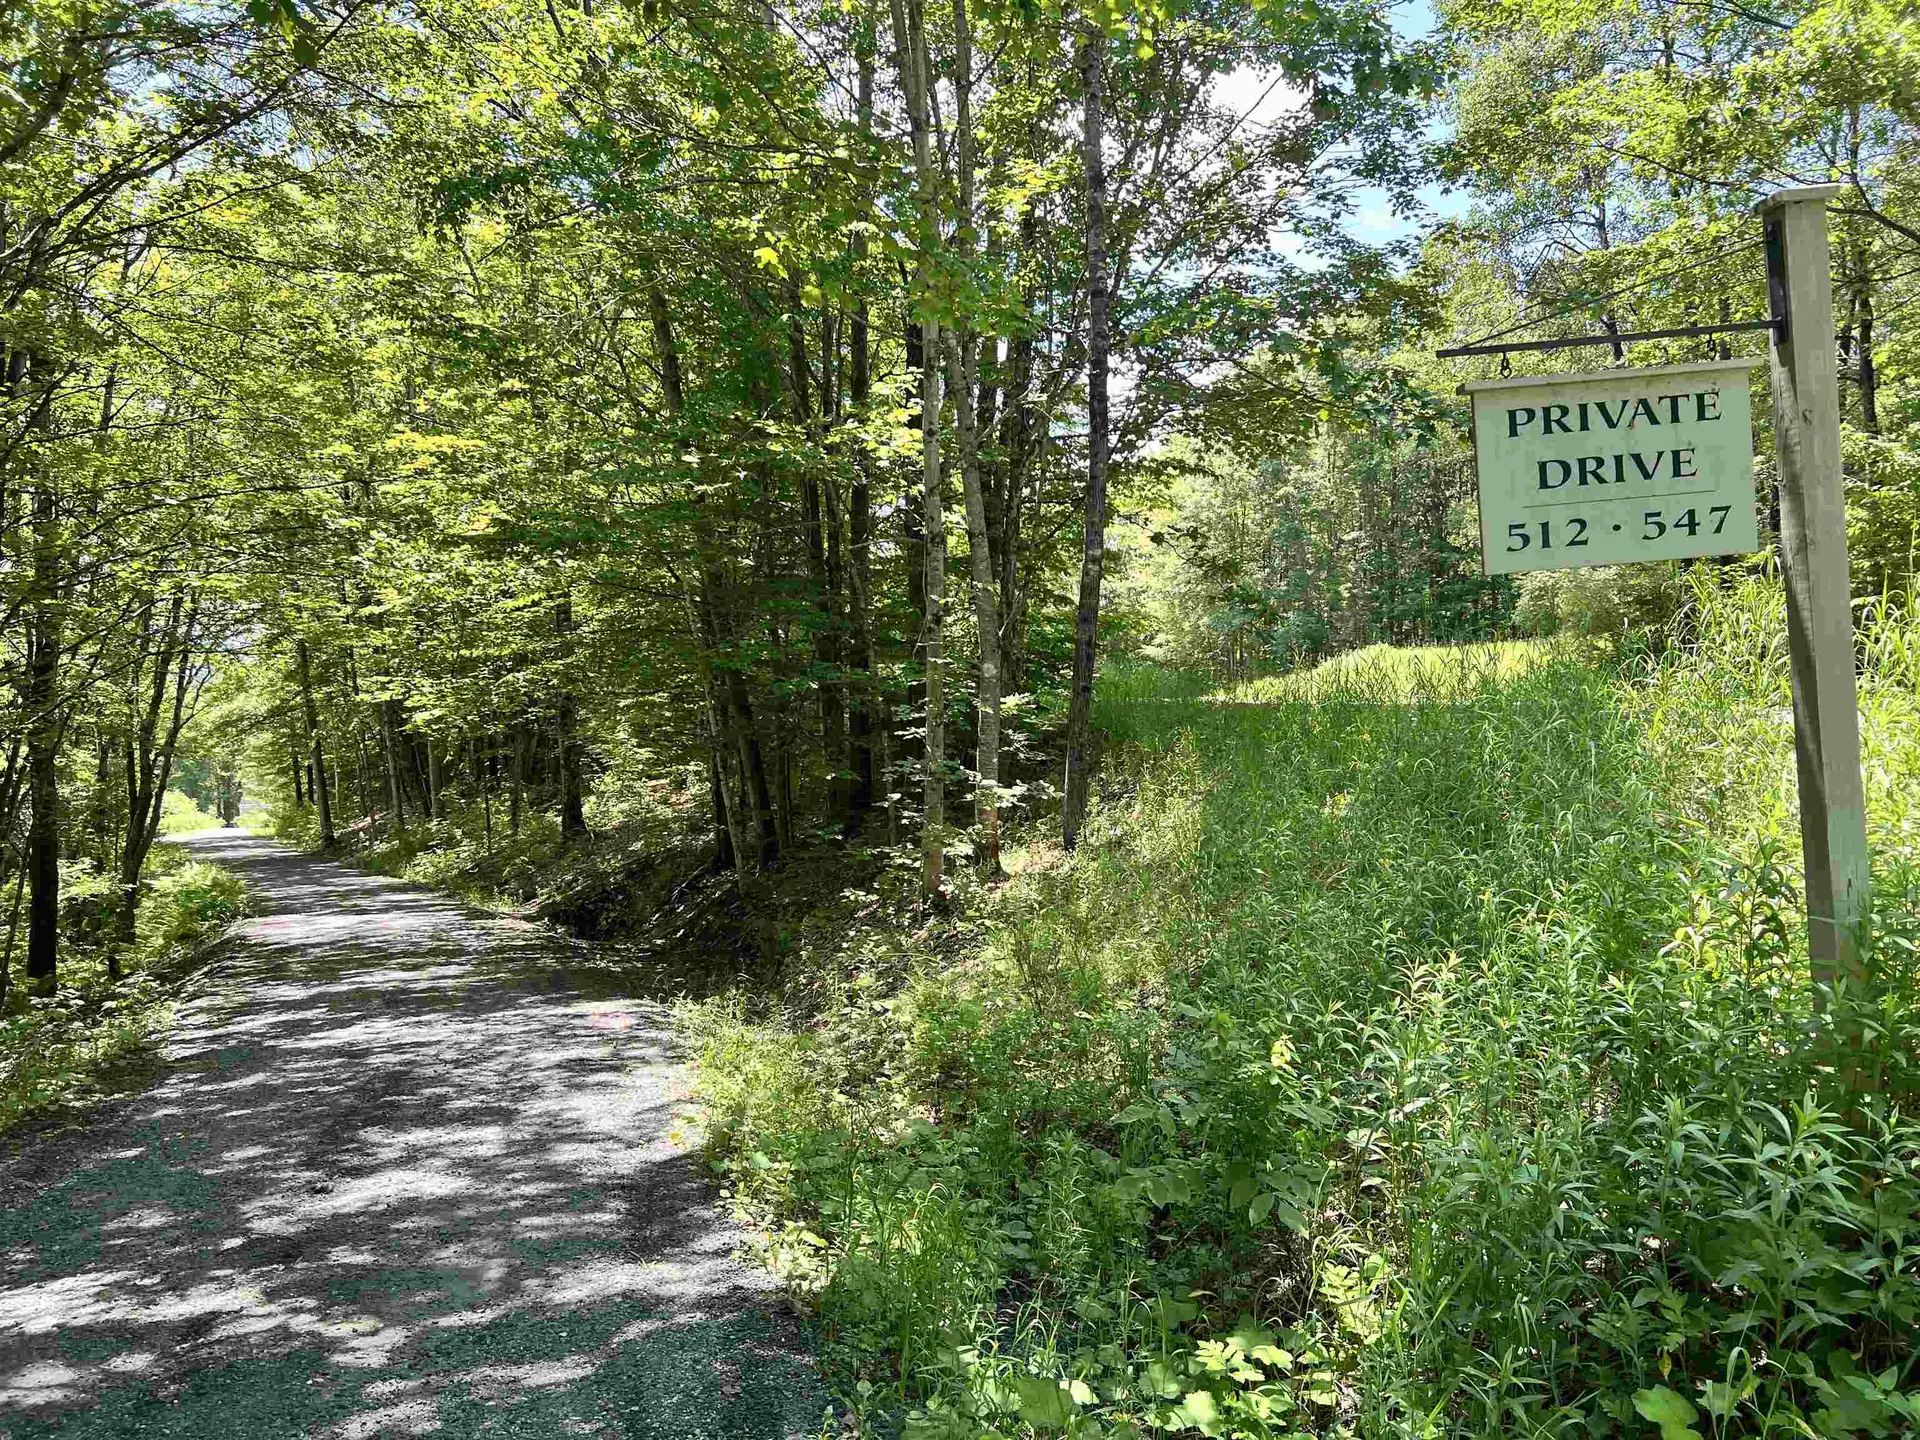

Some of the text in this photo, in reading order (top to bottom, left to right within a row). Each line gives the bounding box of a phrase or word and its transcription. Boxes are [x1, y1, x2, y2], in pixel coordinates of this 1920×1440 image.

[1505, 391, 1723, 438] PRIVATE
[1537, 447, 1698, 490] DRIVE
[1506, 517, 1590, 552] 512
[1641, 505, 1732, 541] 547
